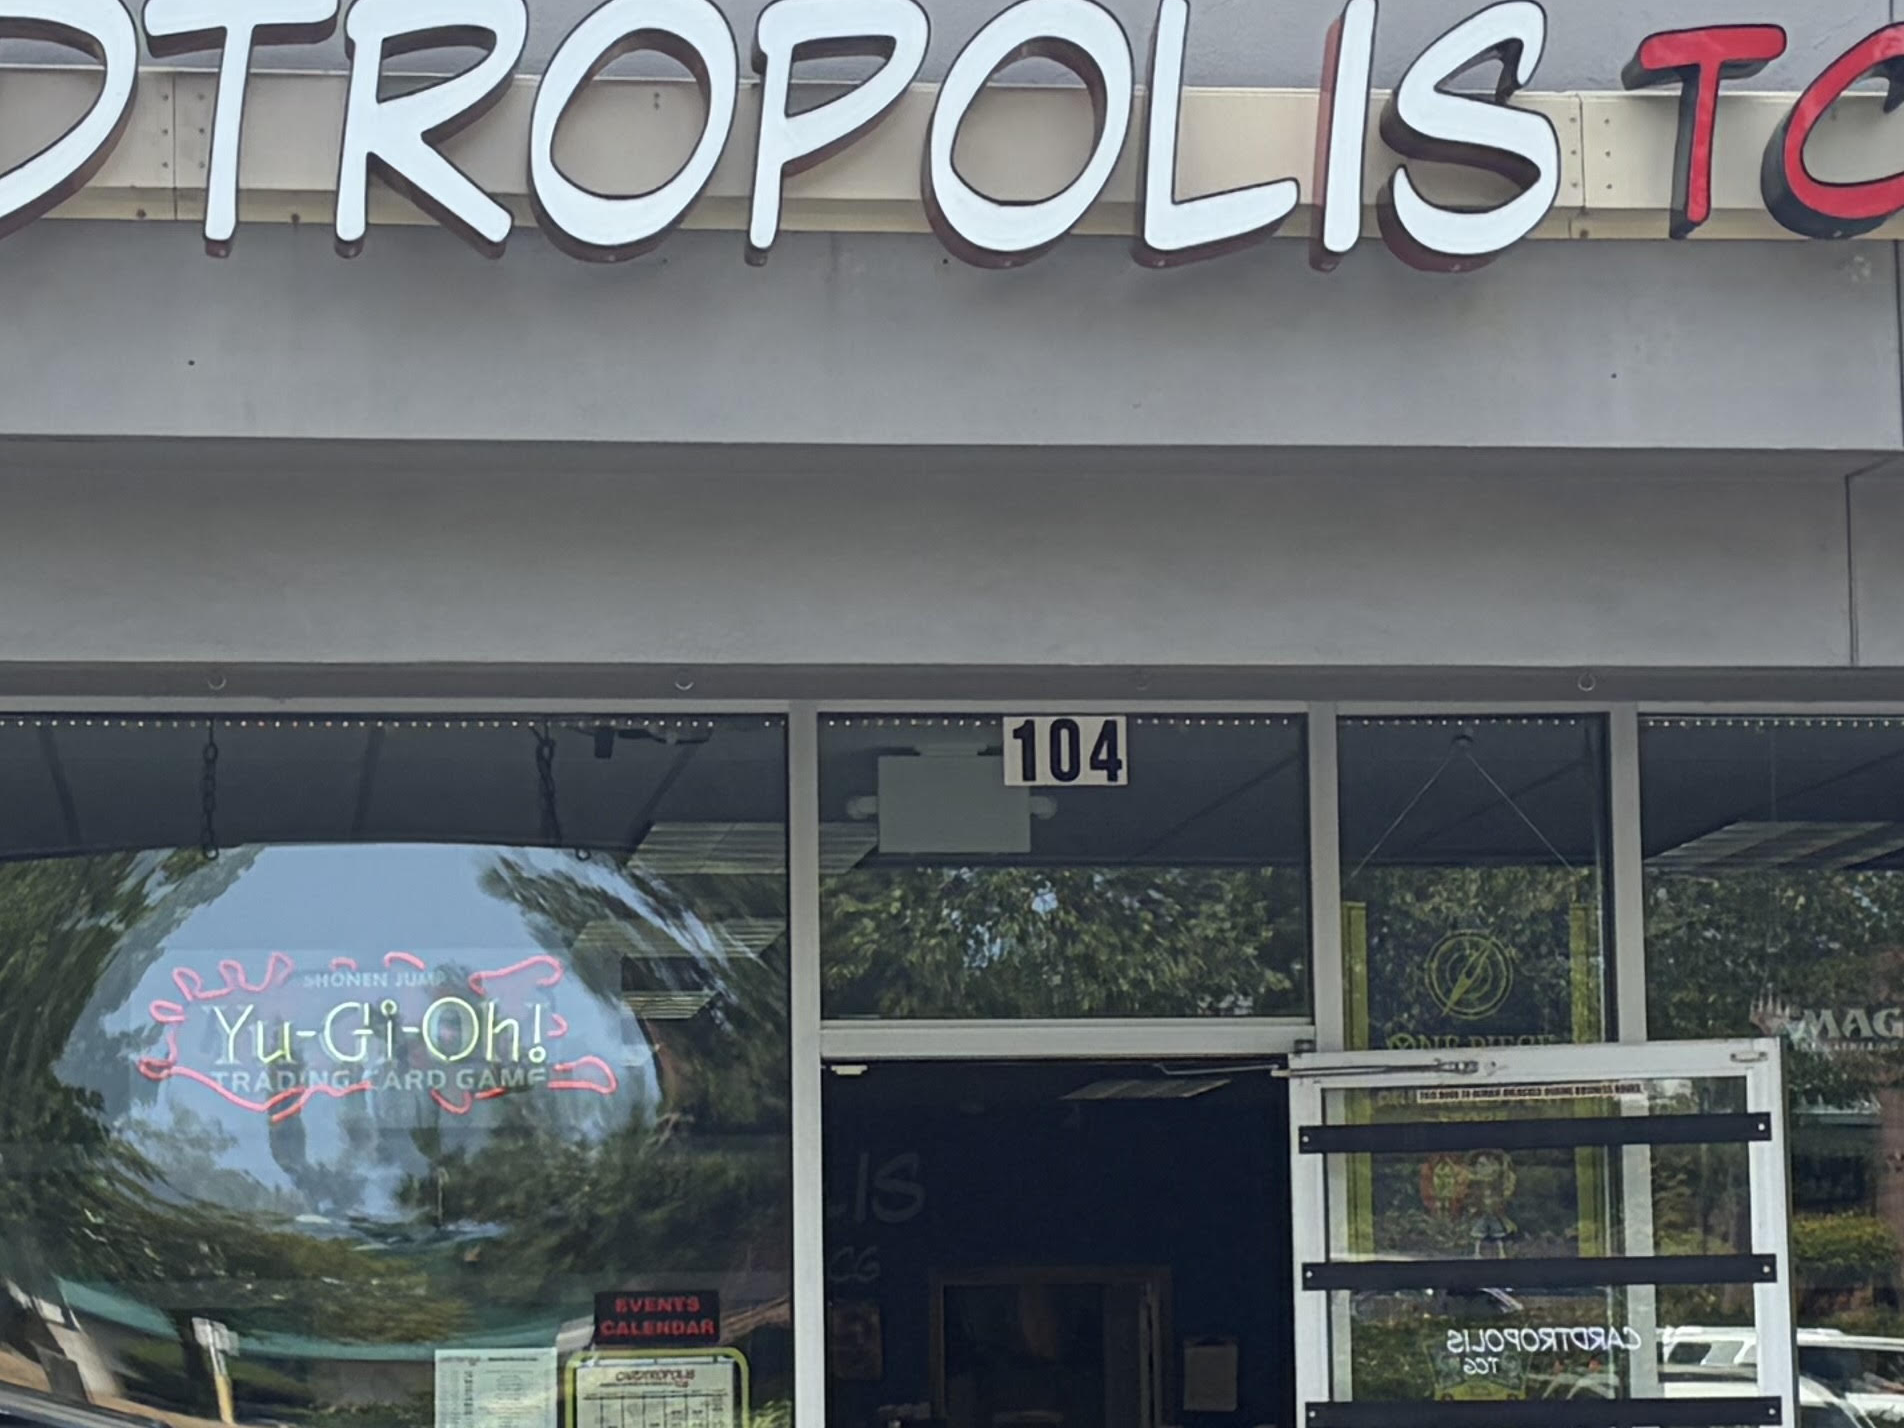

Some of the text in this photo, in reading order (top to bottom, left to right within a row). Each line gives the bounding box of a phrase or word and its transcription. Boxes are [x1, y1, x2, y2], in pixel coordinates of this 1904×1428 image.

[1013, 718, 1123, 782] 104
[213, 996, 547, 1064] Yu-Gi-Oh!
[213, 1069, 547, 1092] TRADING CARD GAME
[615, 1298, 700, 1312] EVENTS
[601, 1320, 714, 1336] CALENDAR
